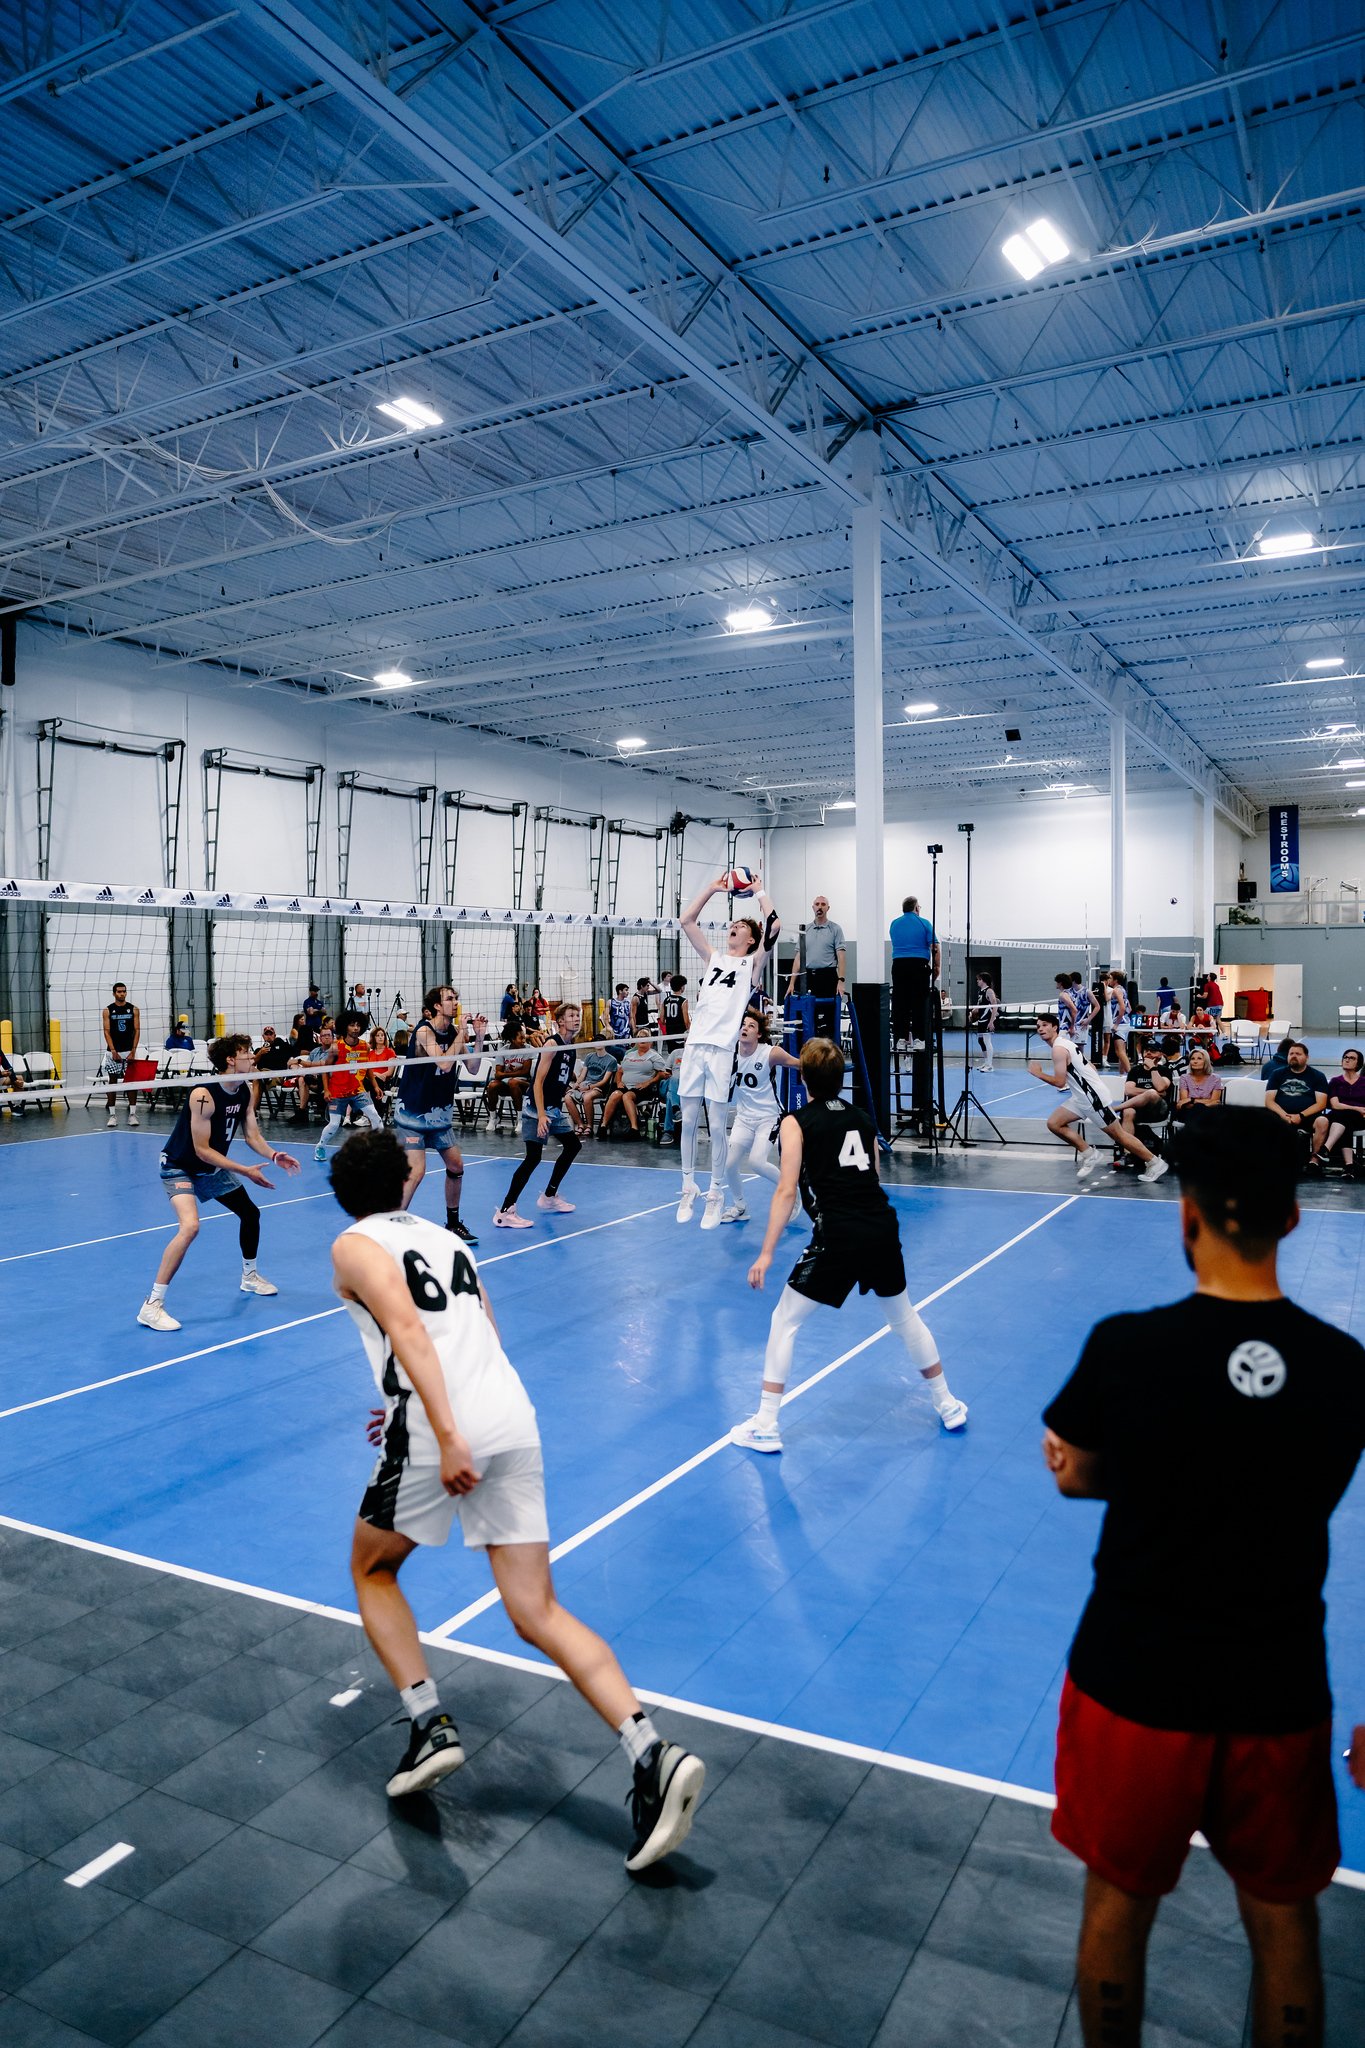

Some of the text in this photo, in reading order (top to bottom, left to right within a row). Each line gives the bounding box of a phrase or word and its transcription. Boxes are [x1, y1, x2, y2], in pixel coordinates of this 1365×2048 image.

[1280, 811, 1289, 878] RESTROOMS
[708, 967, 737, 989] 74
[615, 1006, 625, 1016] 13
[665, 1002, 679, 1018] 10
[118, 1020, 126, 1031] 5
[1132, 1016, 1142, 1026] 16
[1148, 1016, 1159, 1026] 18
[225, 1118, 235, 1142] 4
[838, 1130, 870, 1171] 4
[403, 1249, 483, 1312] 64
